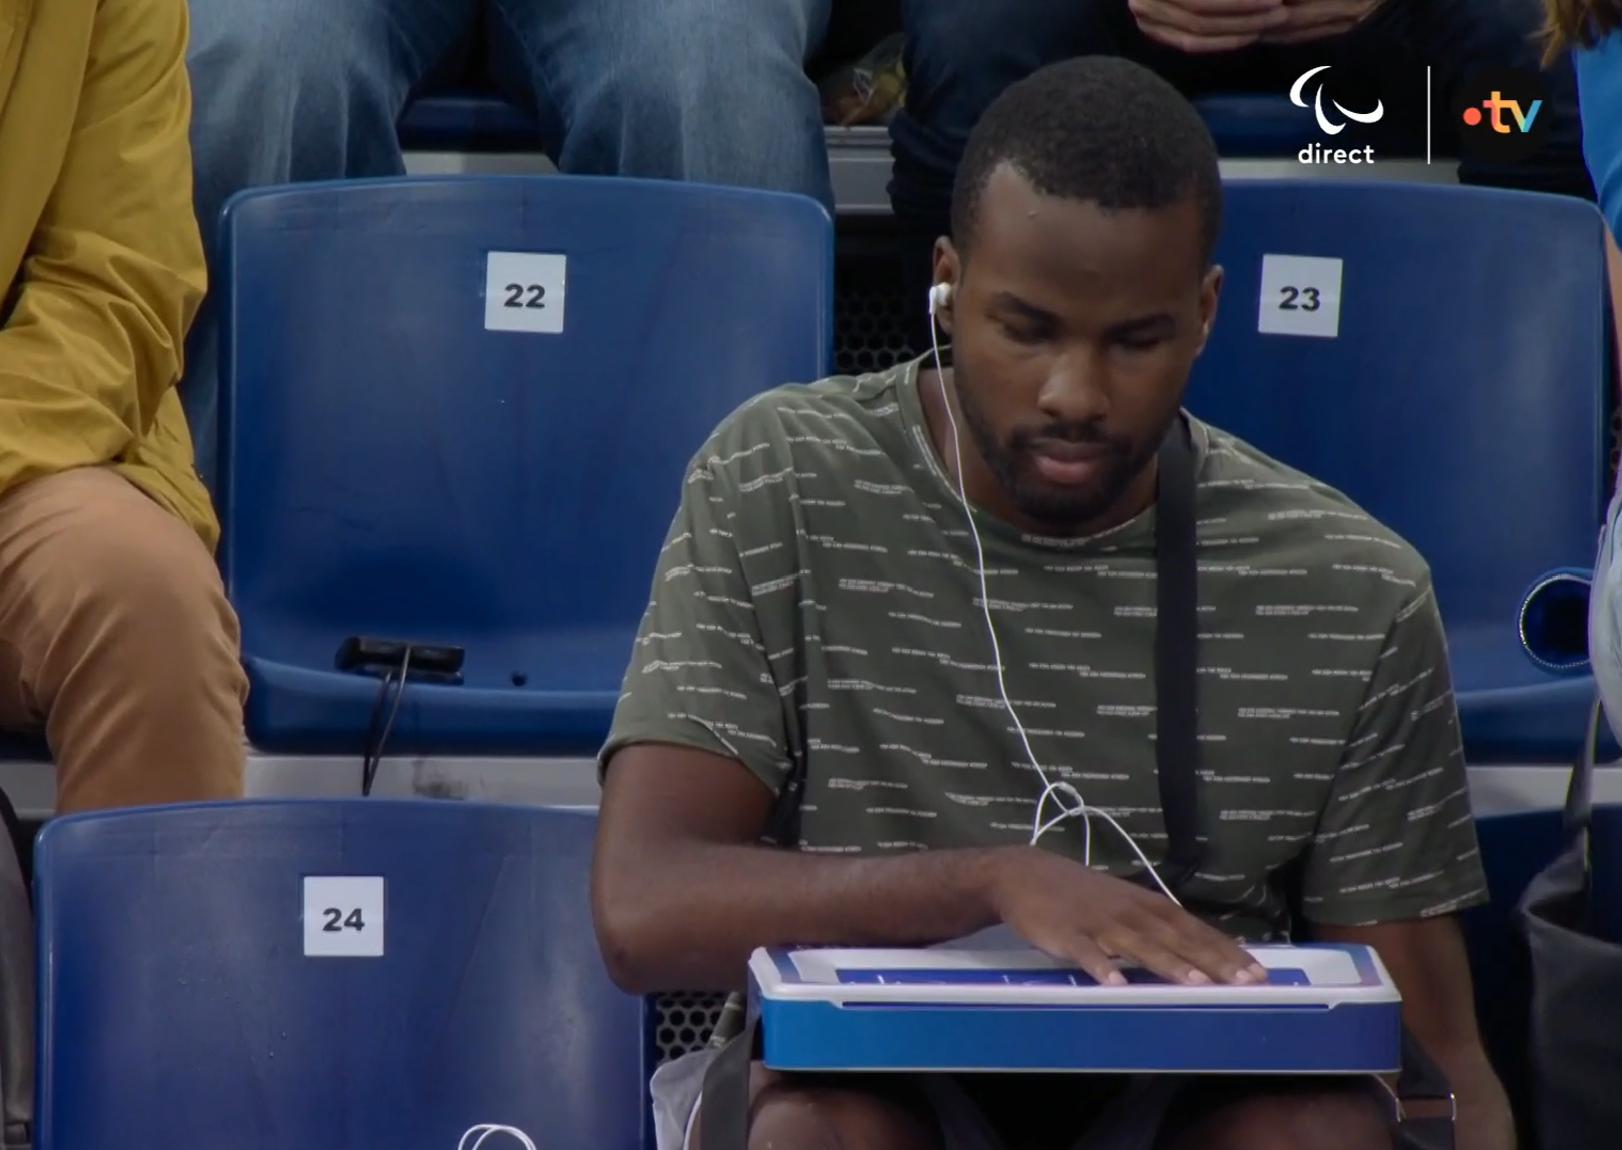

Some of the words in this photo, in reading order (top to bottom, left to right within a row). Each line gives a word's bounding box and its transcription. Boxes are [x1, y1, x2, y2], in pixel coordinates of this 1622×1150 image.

[503, 283, 546, 309] 22
[1278, 285, 1321, 312] 23
[322, 907, 365, 932] 24
